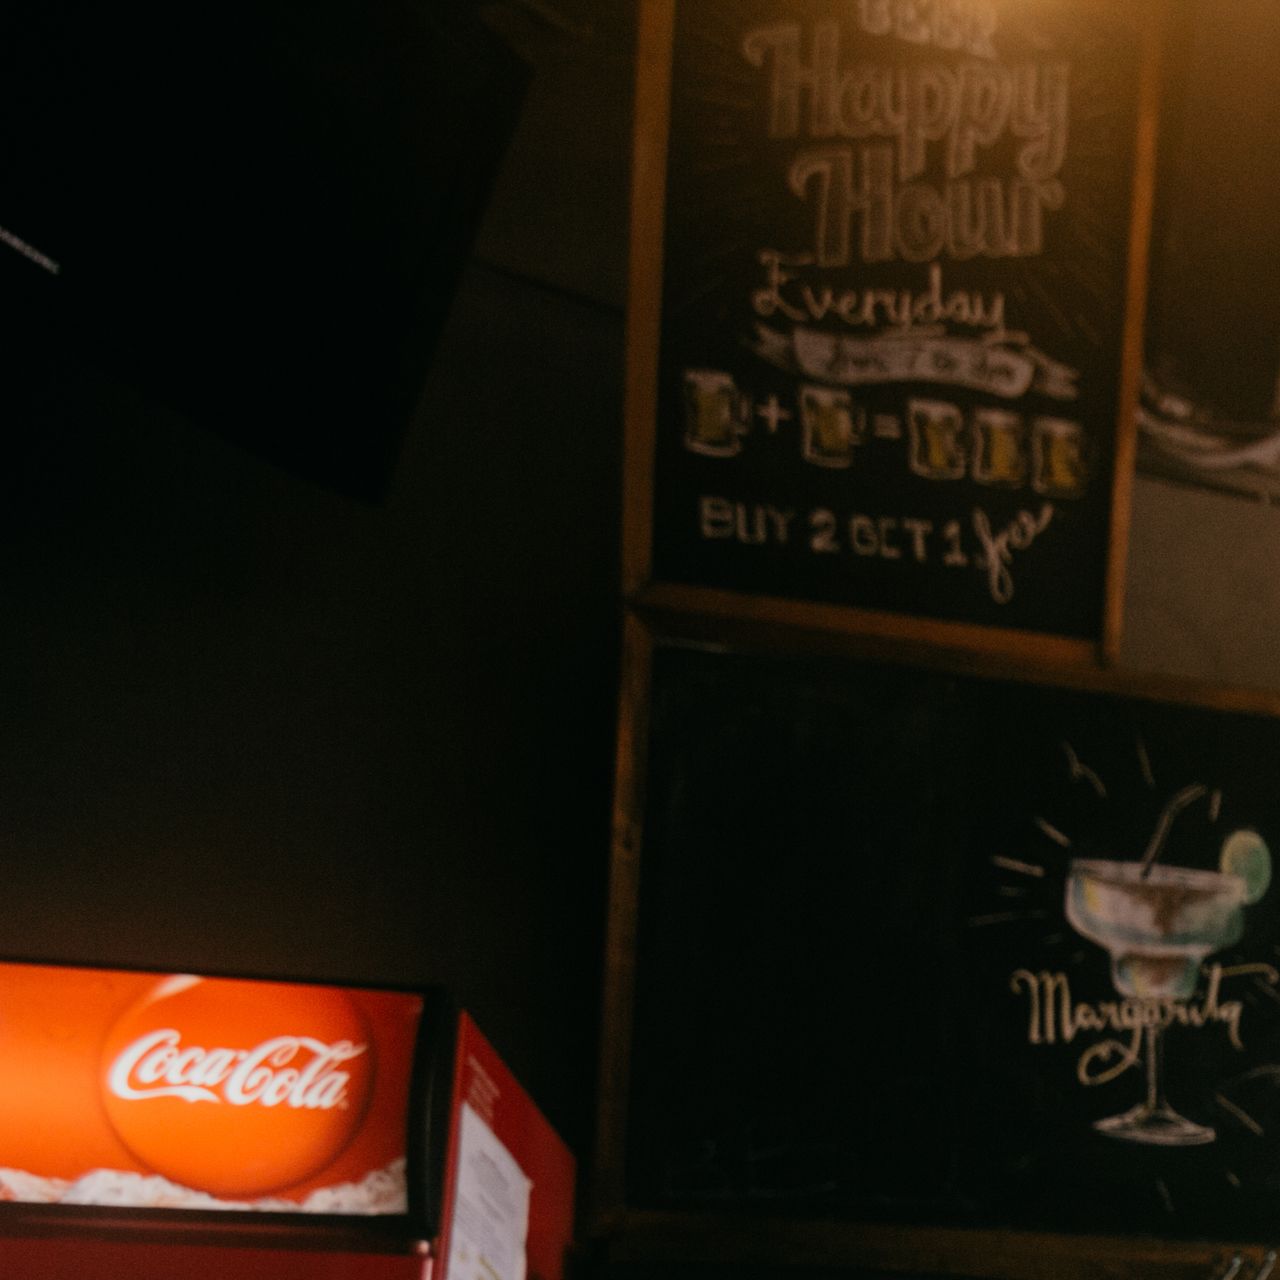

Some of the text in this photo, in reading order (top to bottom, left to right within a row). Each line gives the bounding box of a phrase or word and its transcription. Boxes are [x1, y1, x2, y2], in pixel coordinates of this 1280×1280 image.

[743, 22, 1071, 180] Happy
[788, 142, 1067, 267] Hour
[751, 248, 1030, 345] Everyday
[701, 498, 794, 544] BUY
[810, 508, 842, 554] 2
[943, 519, 969, 568] 1
[108, 1028, 367, 1109] Coca-Cola
